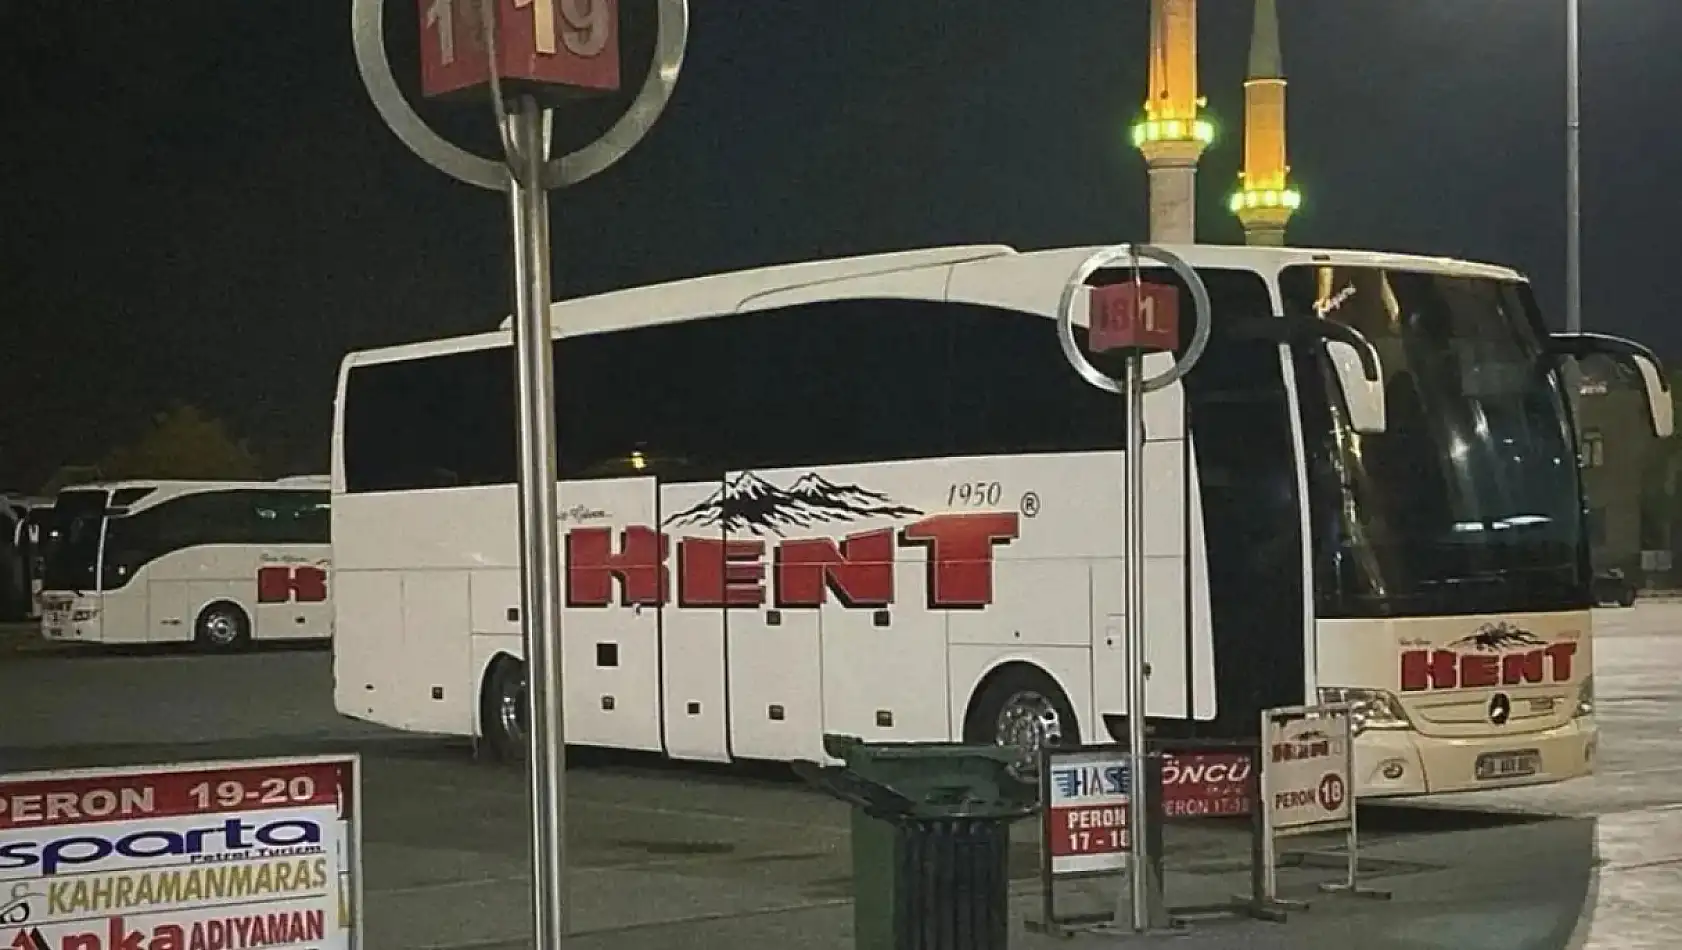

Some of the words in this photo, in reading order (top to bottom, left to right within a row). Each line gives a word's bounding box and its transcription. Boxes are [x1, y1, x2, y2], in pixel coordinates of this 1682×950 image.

[514, 0, 608, 56] 19
[948, 482, 1002, 506] 1950
[565, 512, 1020, 609] KENT
[1401, 641, 1576, 691] KENT
[1162, 756, 1250, 785] ÖNCÜ
[0, 787, 155, 821] ERON
[189, 776, 314, 808] 19-20
[1068, 807, 1125, 829] PERON
[1069, 832, 1090, 850] 17
[47, 859, 327, 915] KAHRAMANMARAS
[190, 909, 324, 950] ADIYAMAN
